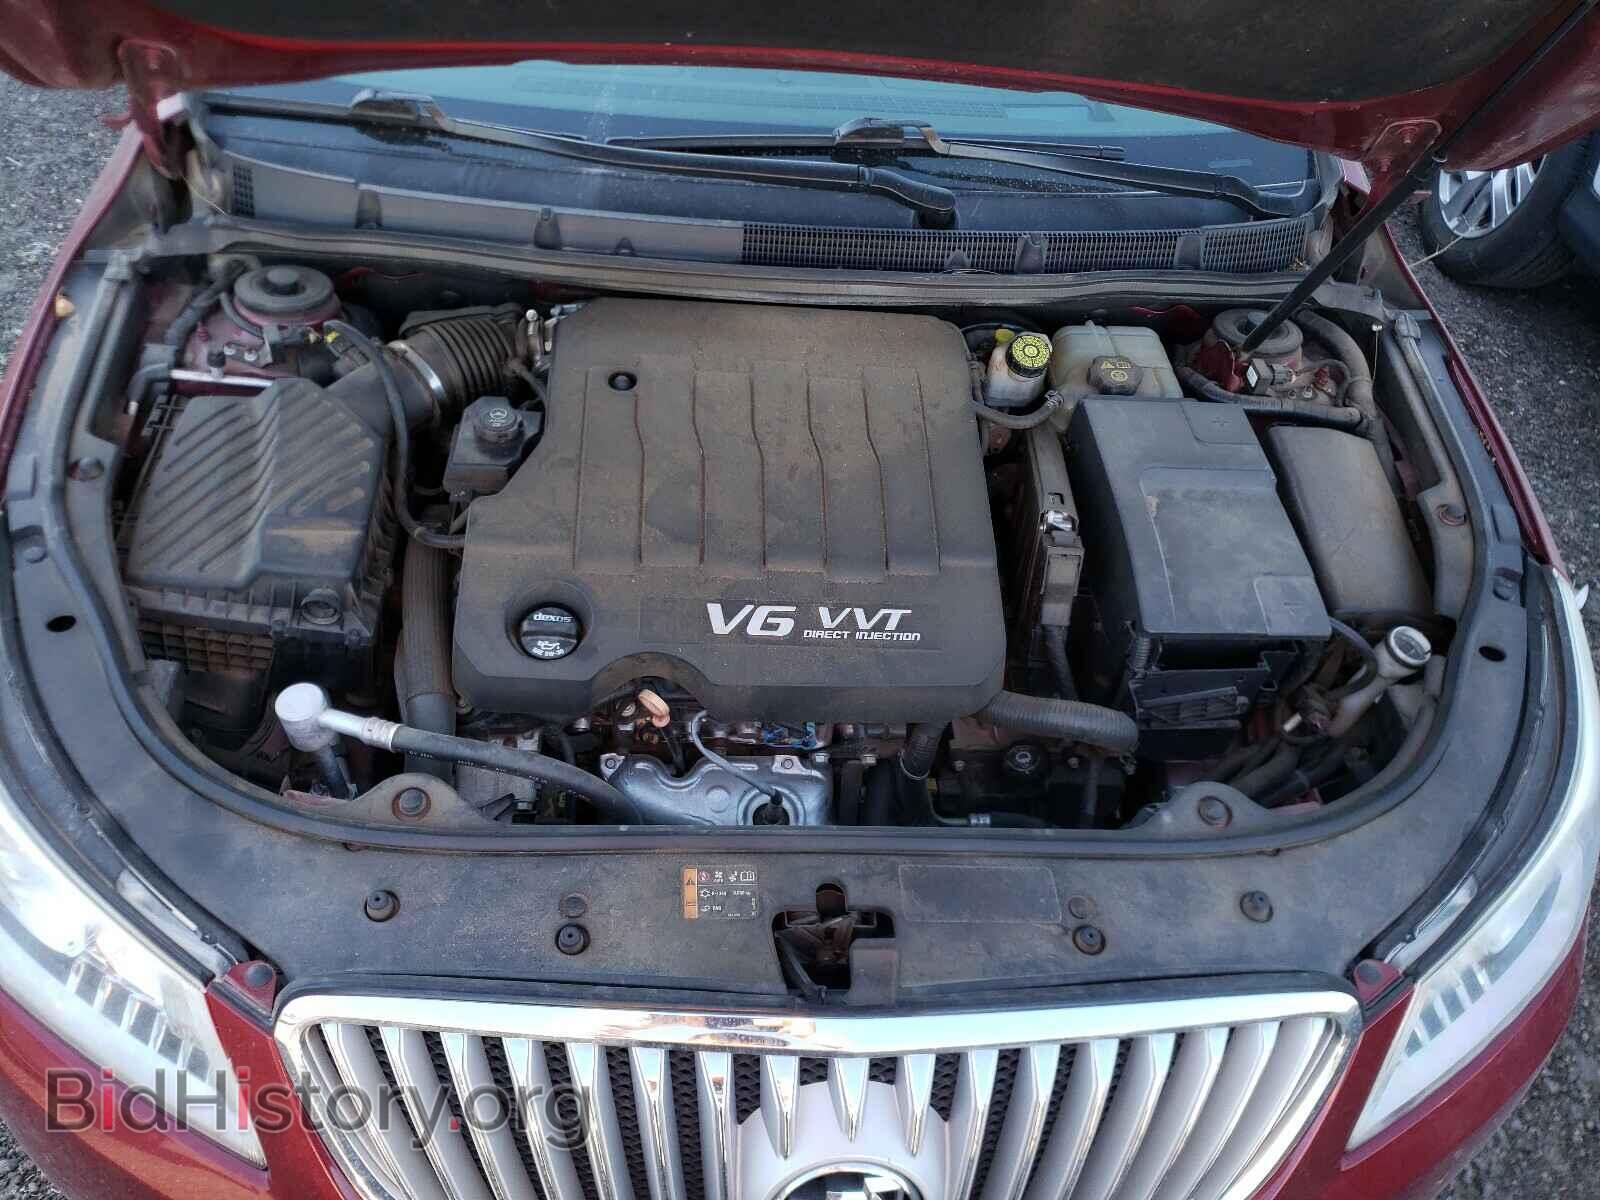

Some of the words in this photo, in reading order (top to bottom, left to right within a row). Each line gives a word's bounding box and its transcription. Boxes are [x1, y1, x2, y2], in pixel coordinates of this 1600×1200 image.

[533, 612, 573, 623] dexos
[706, 602, 797, 637] V6
[818, 606, 913, 631] VVT
[803, 629, 850, 640] DIRECT
[855, 631, 921, 641] INJECTION
